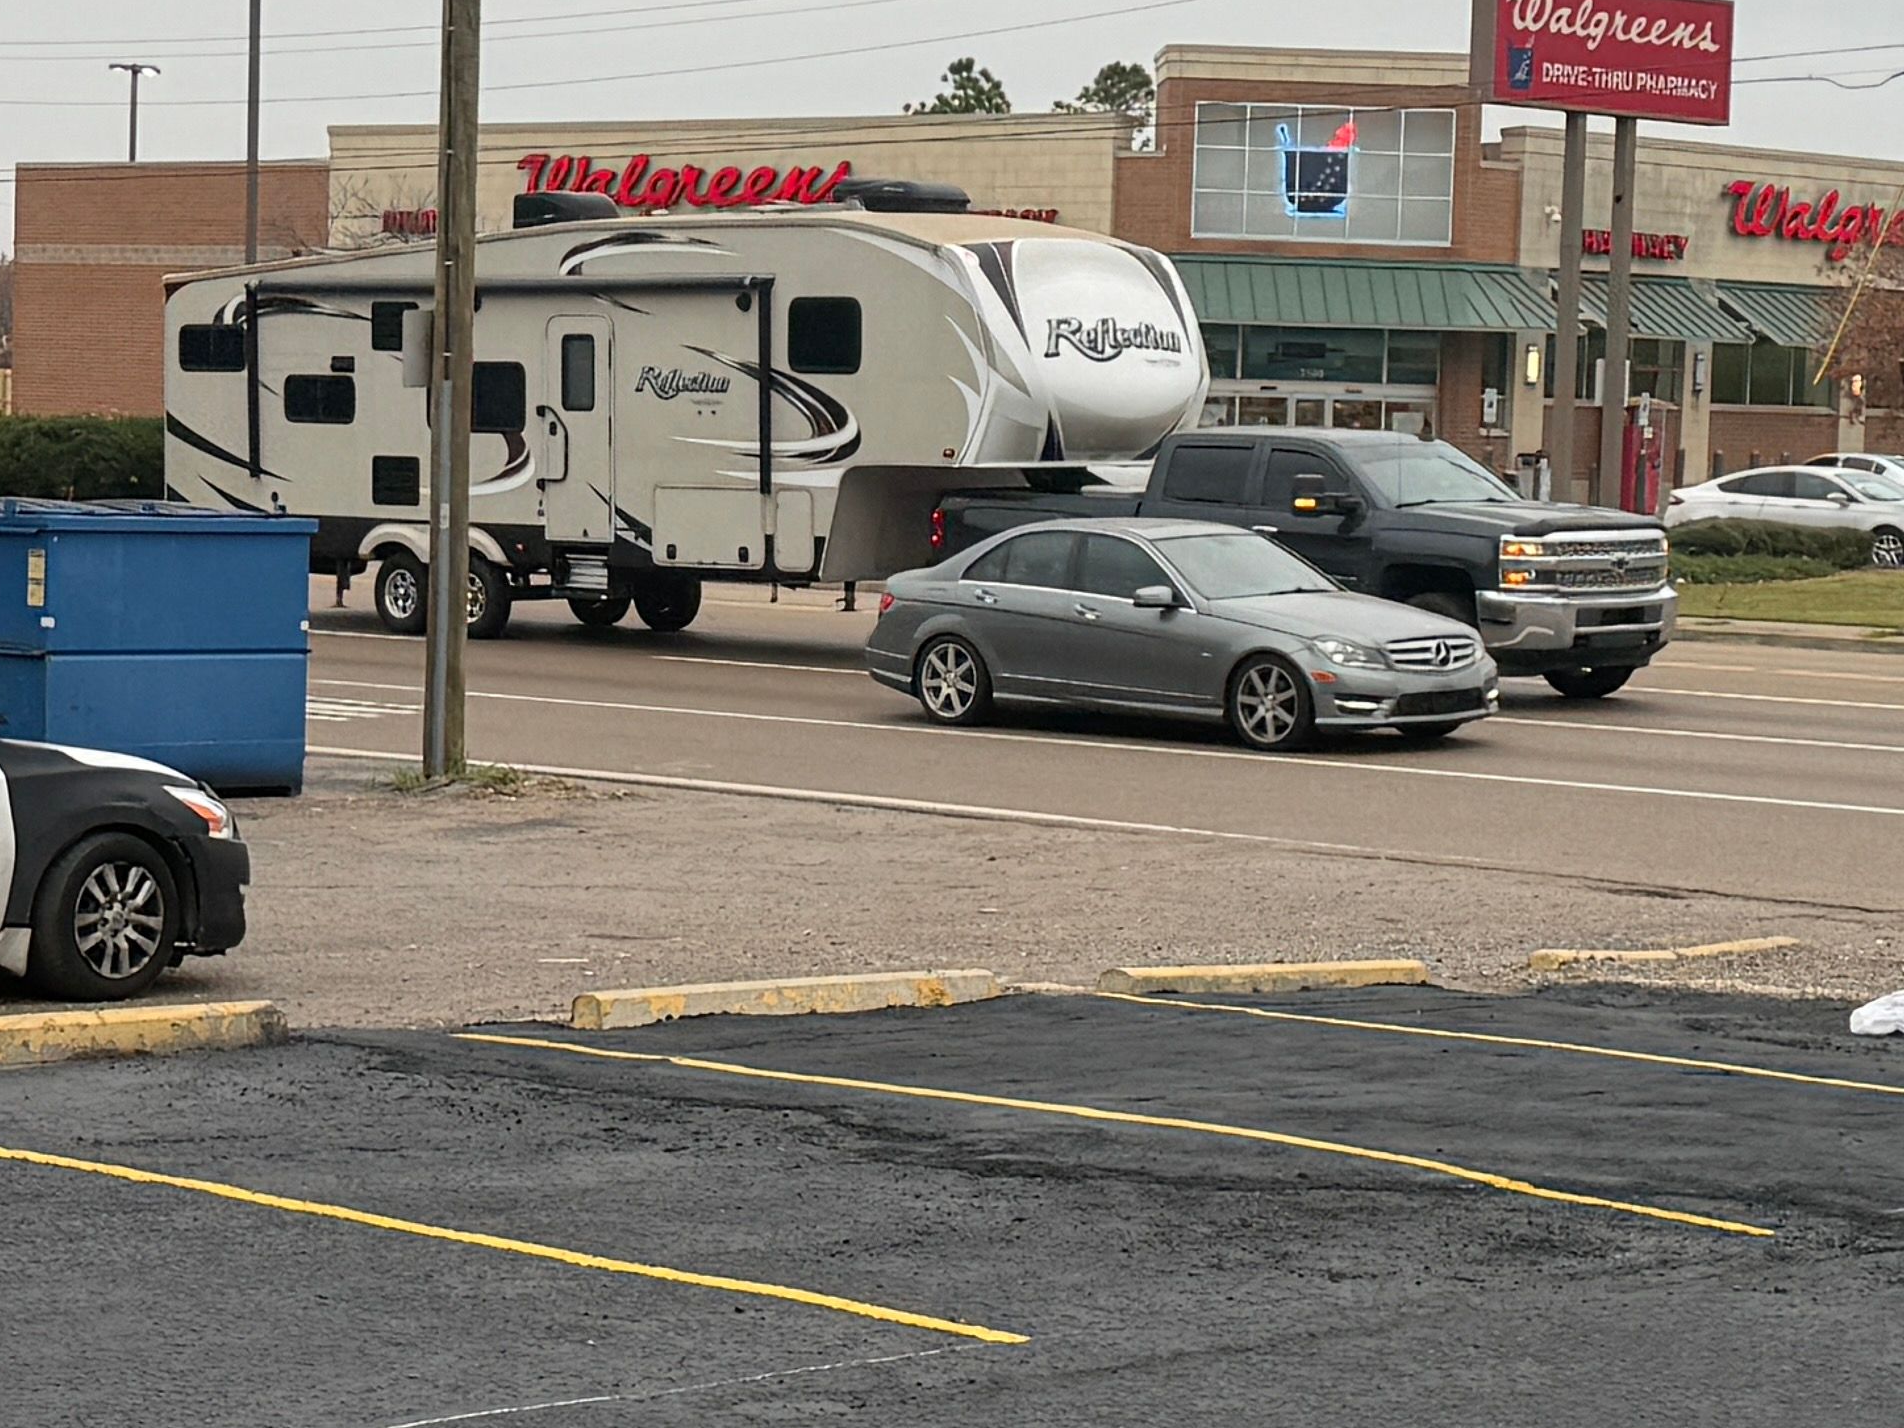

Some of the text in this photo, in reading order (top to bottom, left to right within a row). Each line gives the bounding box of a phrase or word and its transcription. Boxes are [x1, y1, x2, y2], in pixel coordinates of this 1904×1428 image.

[1542, 62, 1718, 101] DRIVE-THRU PHARMACY
[1044, 317, 1181, 363] Reflection
